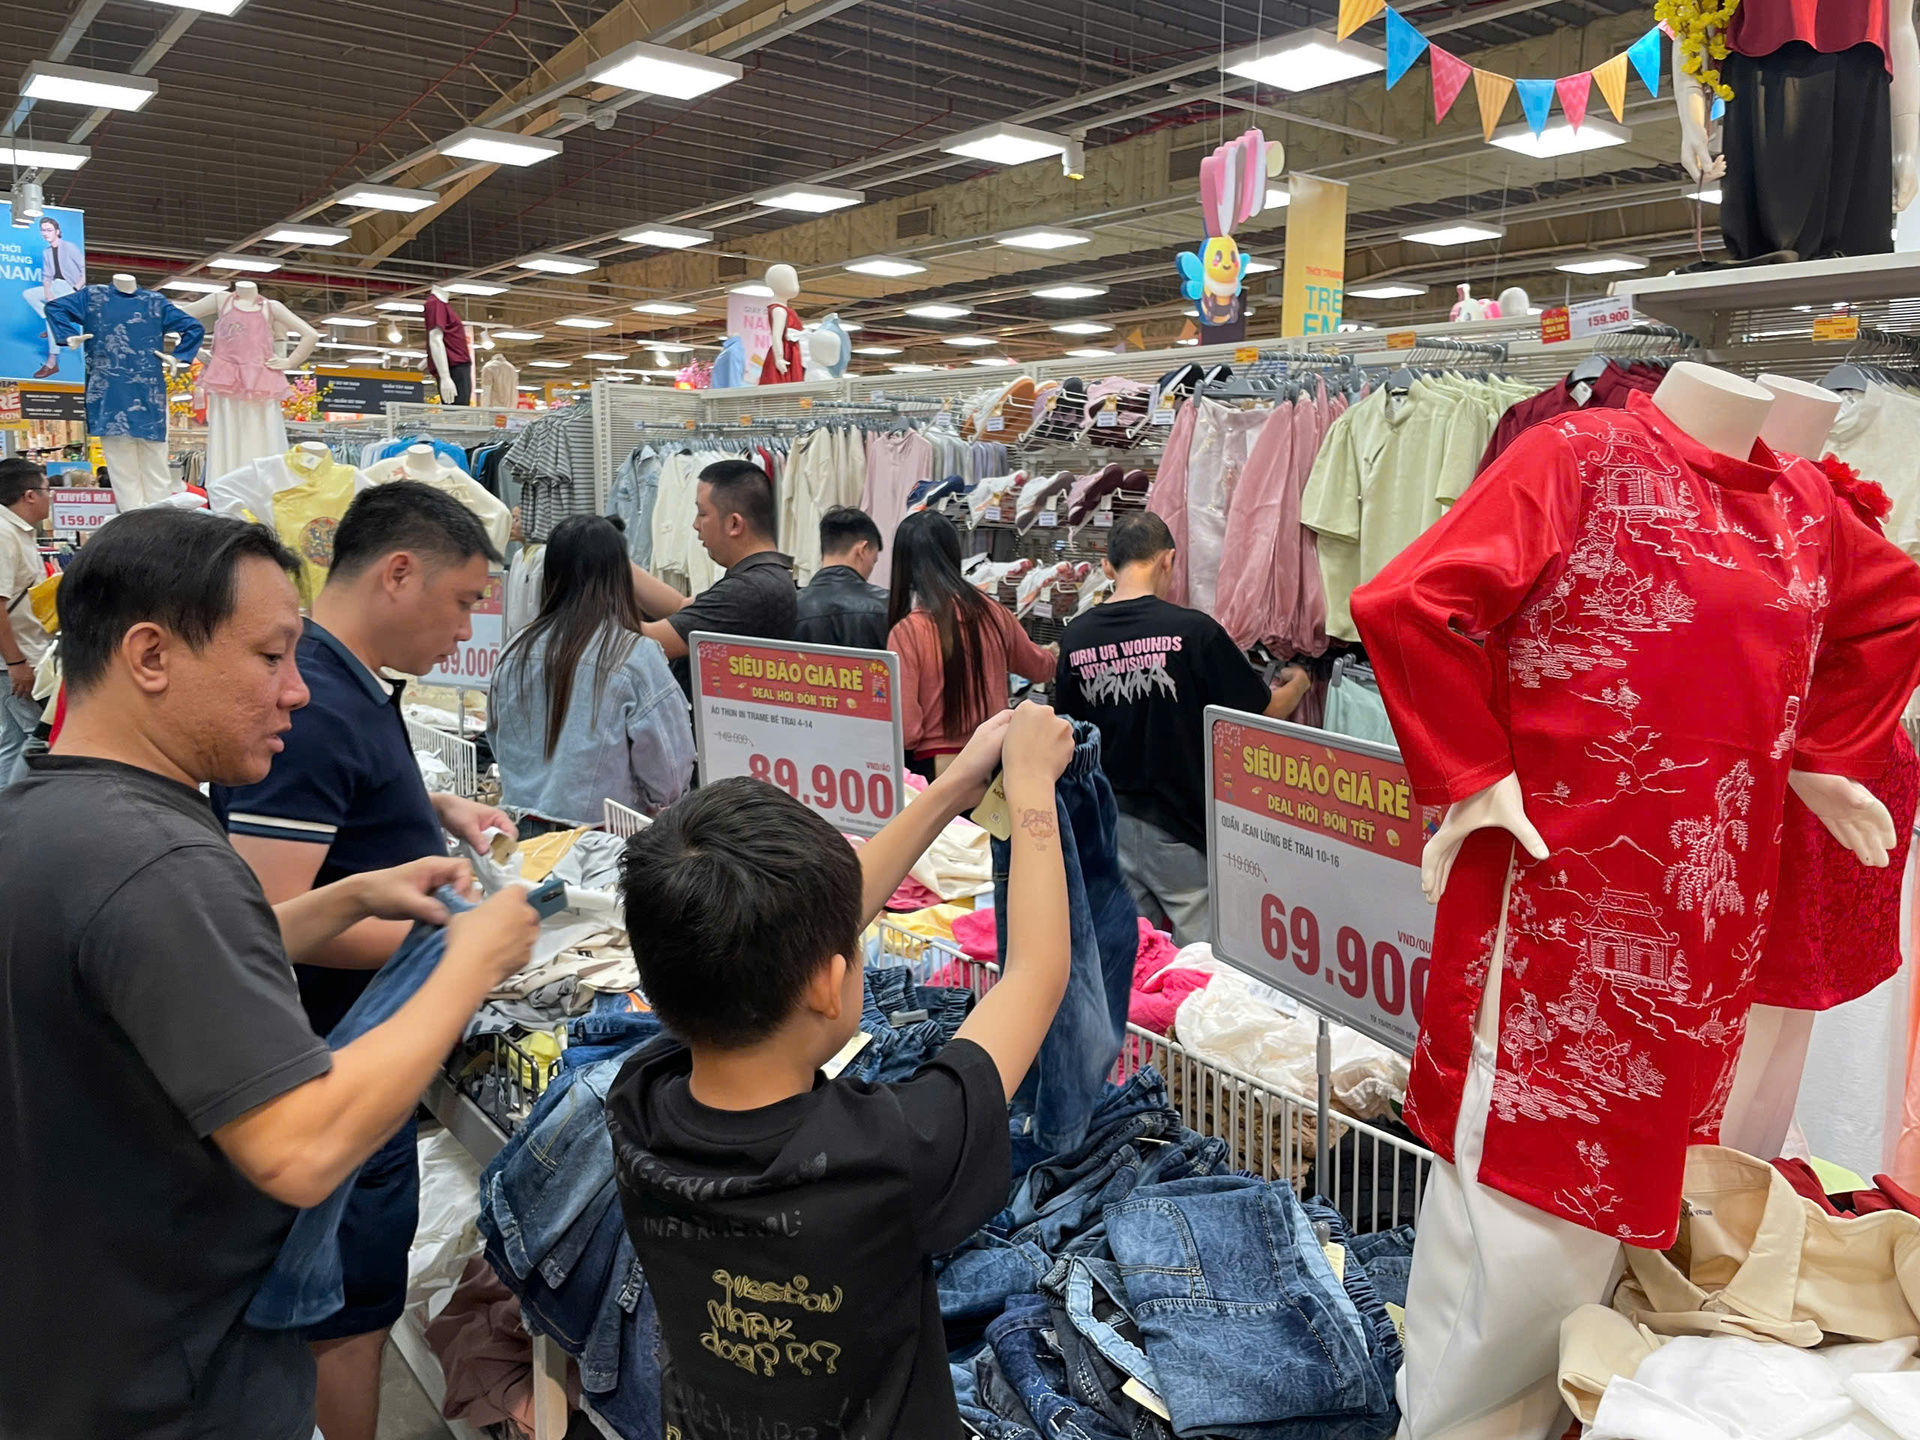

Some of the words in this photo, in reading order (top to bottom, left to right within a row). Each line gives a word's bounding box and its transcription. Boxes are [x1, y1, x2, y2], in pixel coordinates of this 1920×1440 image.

[1588, 310, 1629, 327] 159.900
[1099, 644, 1118, 661] UR
[1120, 636, 1182, 656] WOUNDS
[729, 654, 763, 678] SIÊU
[766, 658, 801, 683] BÃO
[804, 663, 838, 688] GIÁ
[839, 666, 864, 691] RẺ
[711, 705, 720, 714] ÁO
[770, 714, 780, 724] BÉ
[752, 687, 775, 700] DEAL
[777, 690, 794, 702] HỜI
[797, 690, 817, 706] ĐÓN
[819, 694, 839, 709] TẾT
[749, 753, 894, 819] 89.900
[1242, 744, 1282, 781] SIÊU
[1285, 755, 1330, 795] BÃO
[1333, 768, 1375, 811] GIÁ
[1378, 778, 1410, 820] RẺ
[1267, 794, 1294, 816] DEAL
[1297, 801, 1319, 824] HỜI
[1323, 810, 1347, 834] ĐÓN
[1351, 819, 1376, 843] TẾT
[1241, 823, 1259, 839] JEAN
[1283, 837, 1293, 852] BÉ
[1295, 841, 1314, 858] TRAI
[1316, 849, 1340, 868] 10-16
